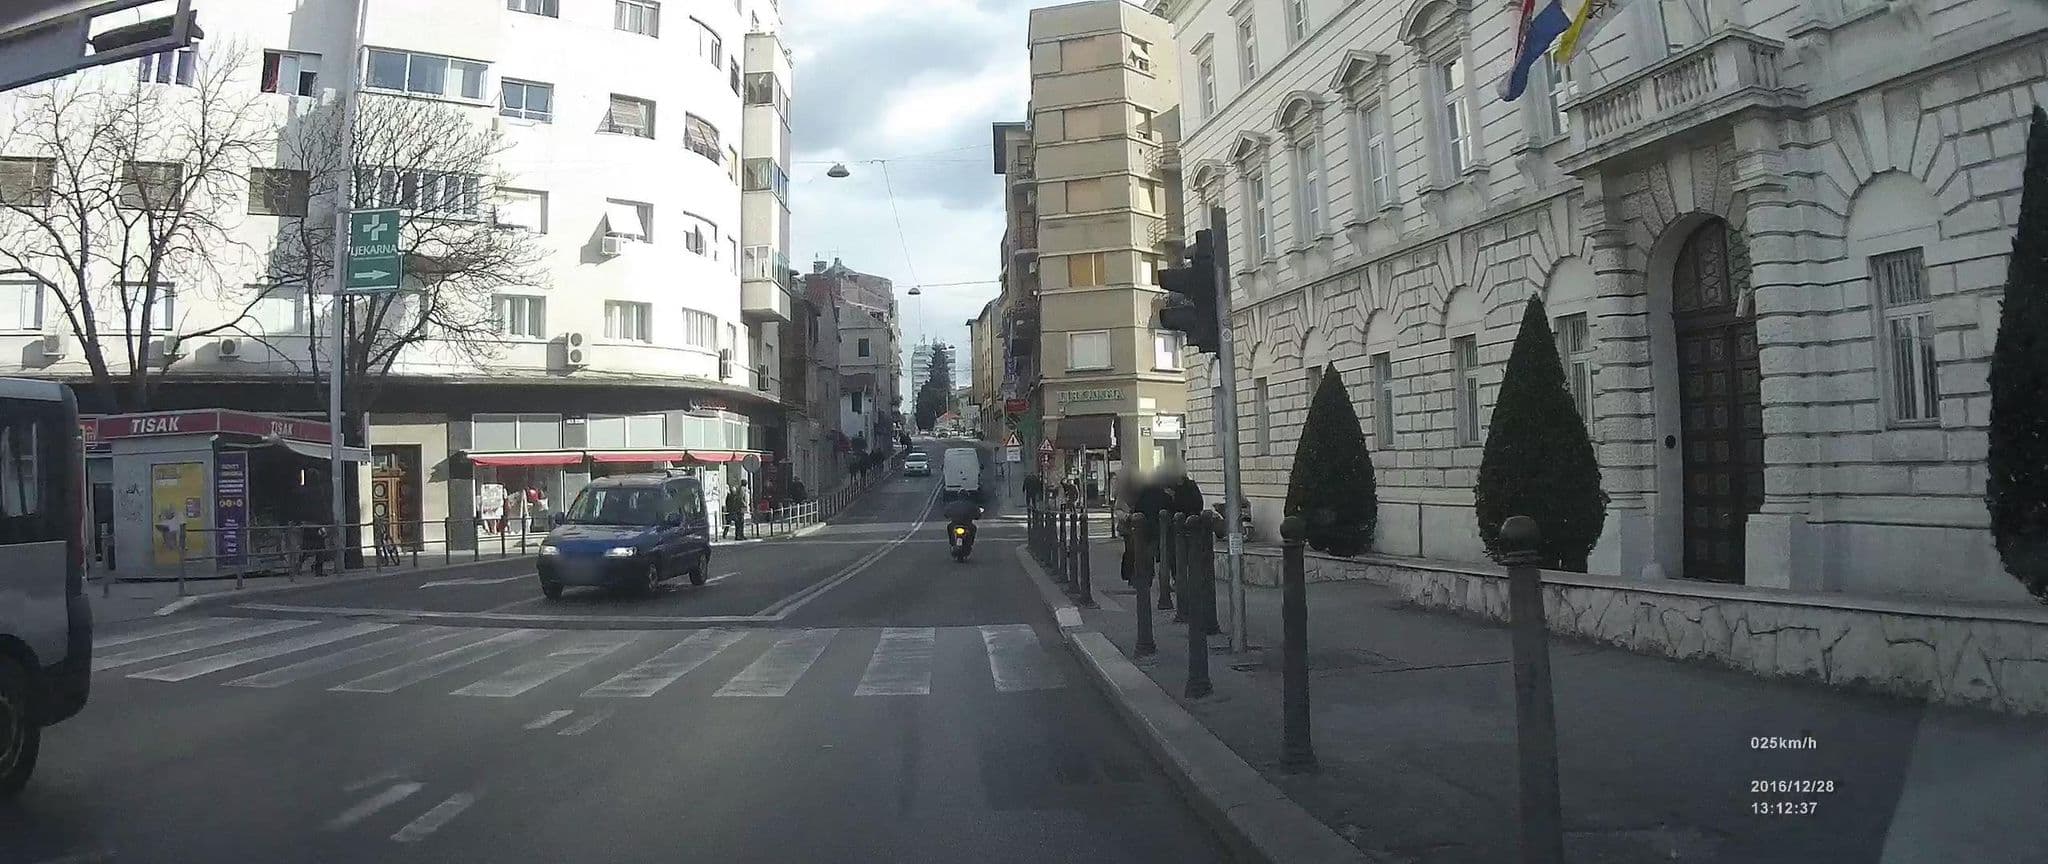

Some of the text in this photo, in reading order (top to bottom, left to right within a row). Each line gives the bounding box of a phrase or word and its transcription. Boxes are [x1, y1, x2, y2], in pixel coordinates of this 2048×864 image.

[351, 244, 397, 256] LJEKARNA
[131, 417, 180, 433] TISAK
[270, 421, 293, 436] TISAK
